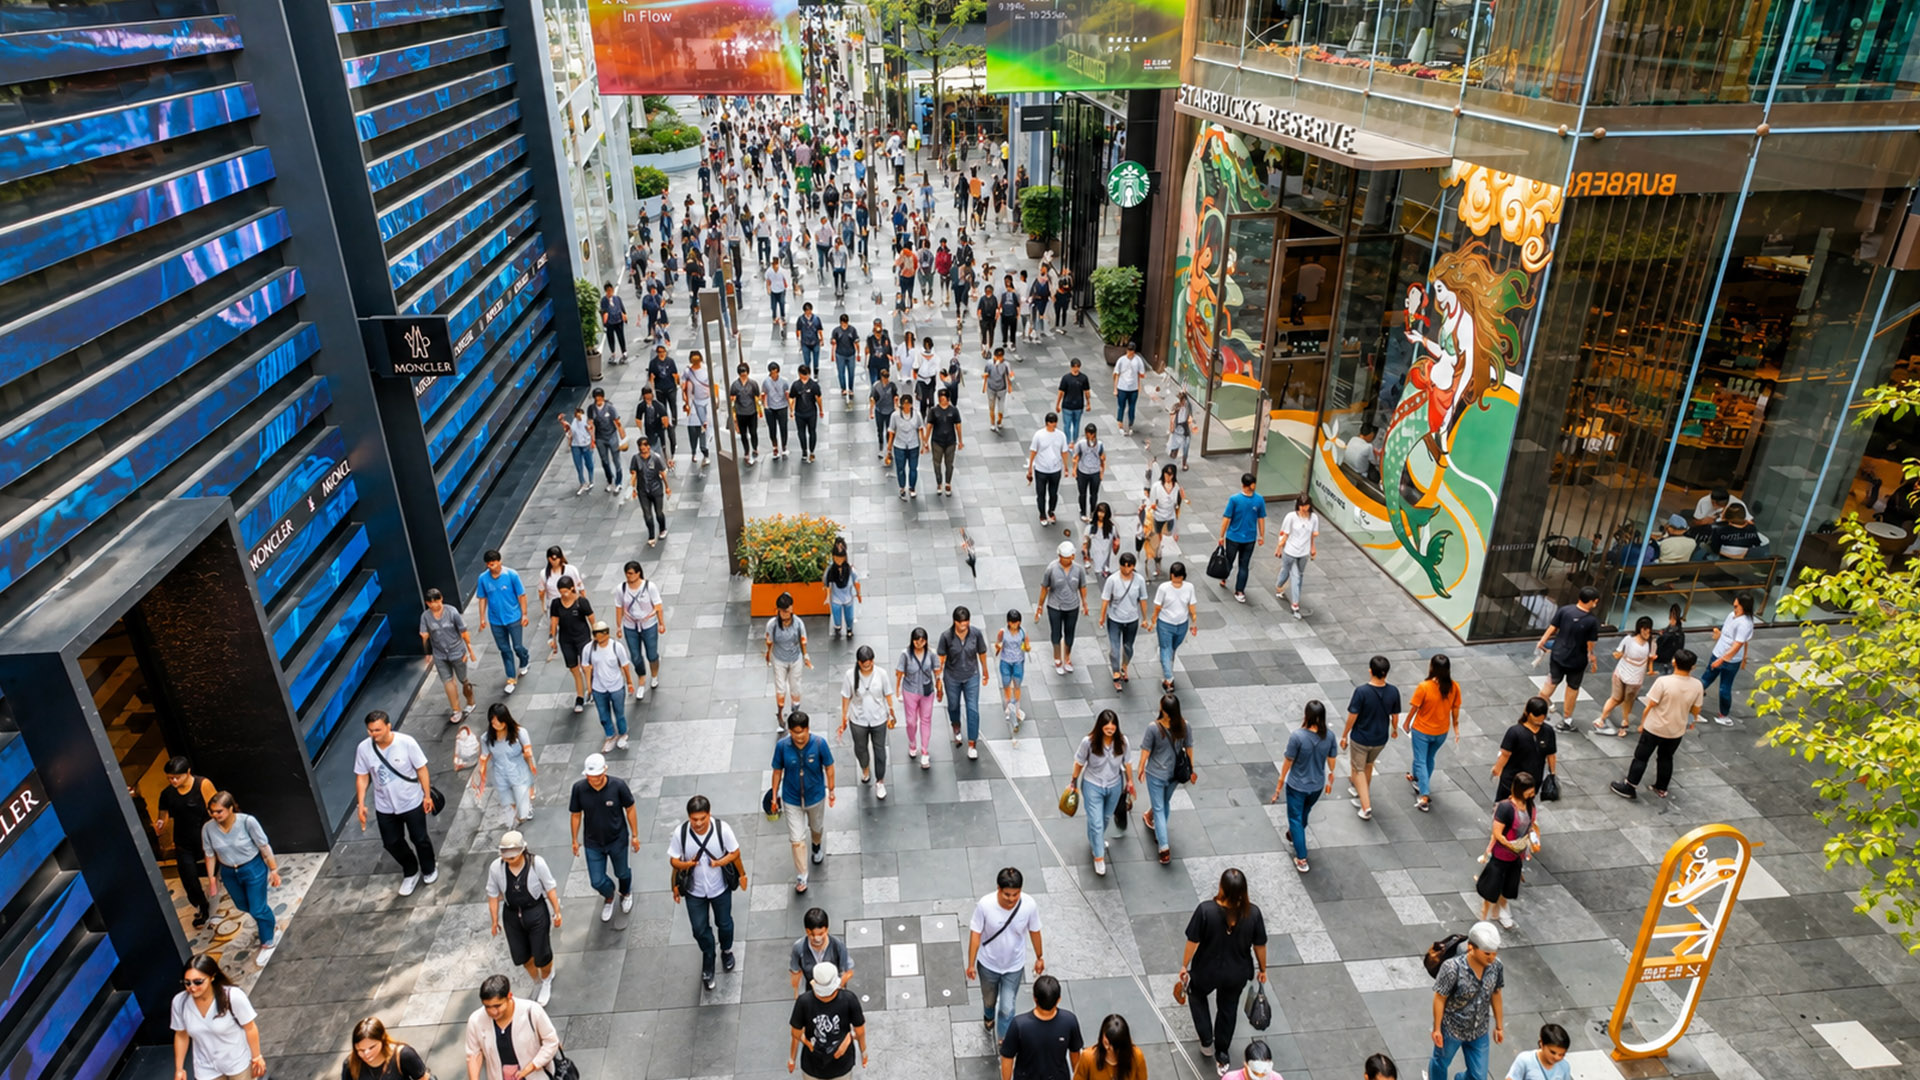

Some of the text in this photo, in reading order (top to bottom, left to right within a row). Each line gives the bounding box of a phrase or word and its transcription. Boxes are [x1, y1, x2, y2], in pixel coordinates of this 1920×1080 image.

[623, 10, 672, 23] In Flow
[1179, 83, 1357, 153] STARBUCKS RESERVE
[394, 362, 452, 373] MONCLER
[249, 519, 294, 572] MONCLER
